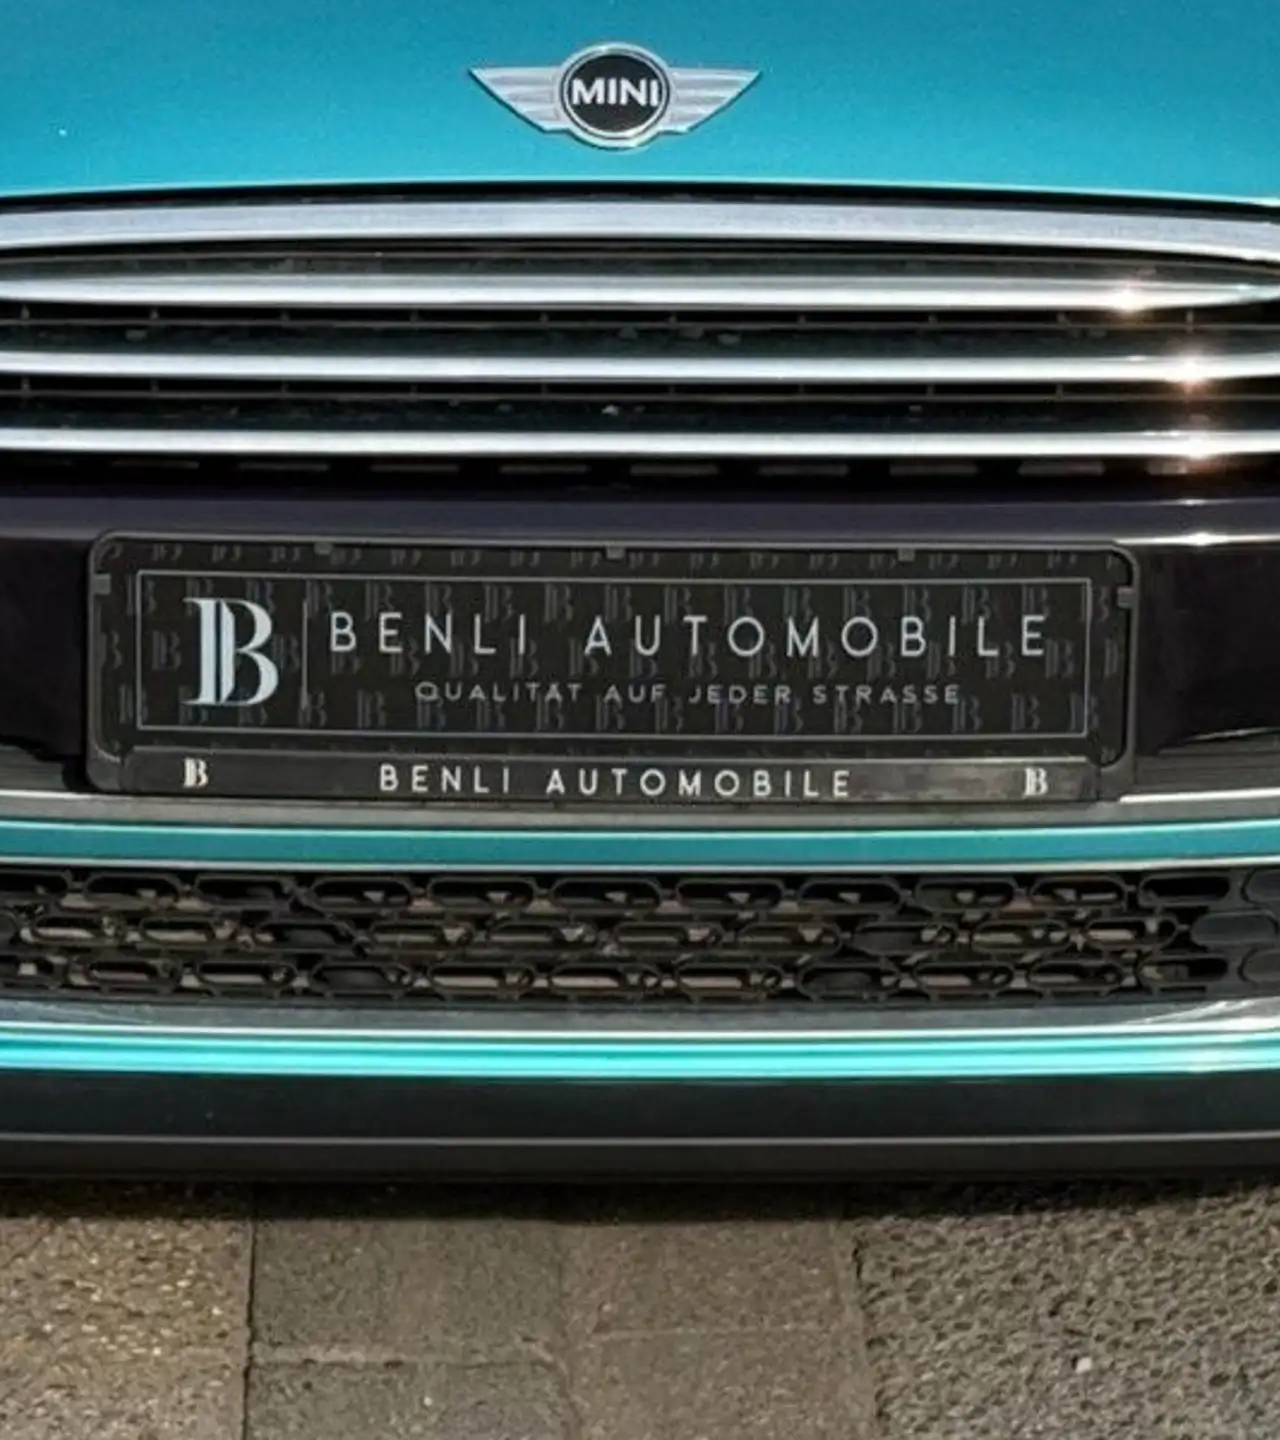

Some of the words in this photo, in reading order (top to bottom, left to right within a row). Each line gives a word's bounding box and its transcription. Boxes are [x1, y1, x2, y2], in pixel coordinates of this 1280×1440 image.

[571, 77, 659, 107] MINI
[330, 611, 526, 656] BENLI
[584, 615, 1045, 658] AUTOMOBILE
[603, 684, 666, 703] AUF
[688, 684, 792, 705] JEDER
[813, 684, 960, 705] STRASSE
[379, 764, 510, 793] BENLI
[546, 768, 851, 798] AUTOMOBILE
